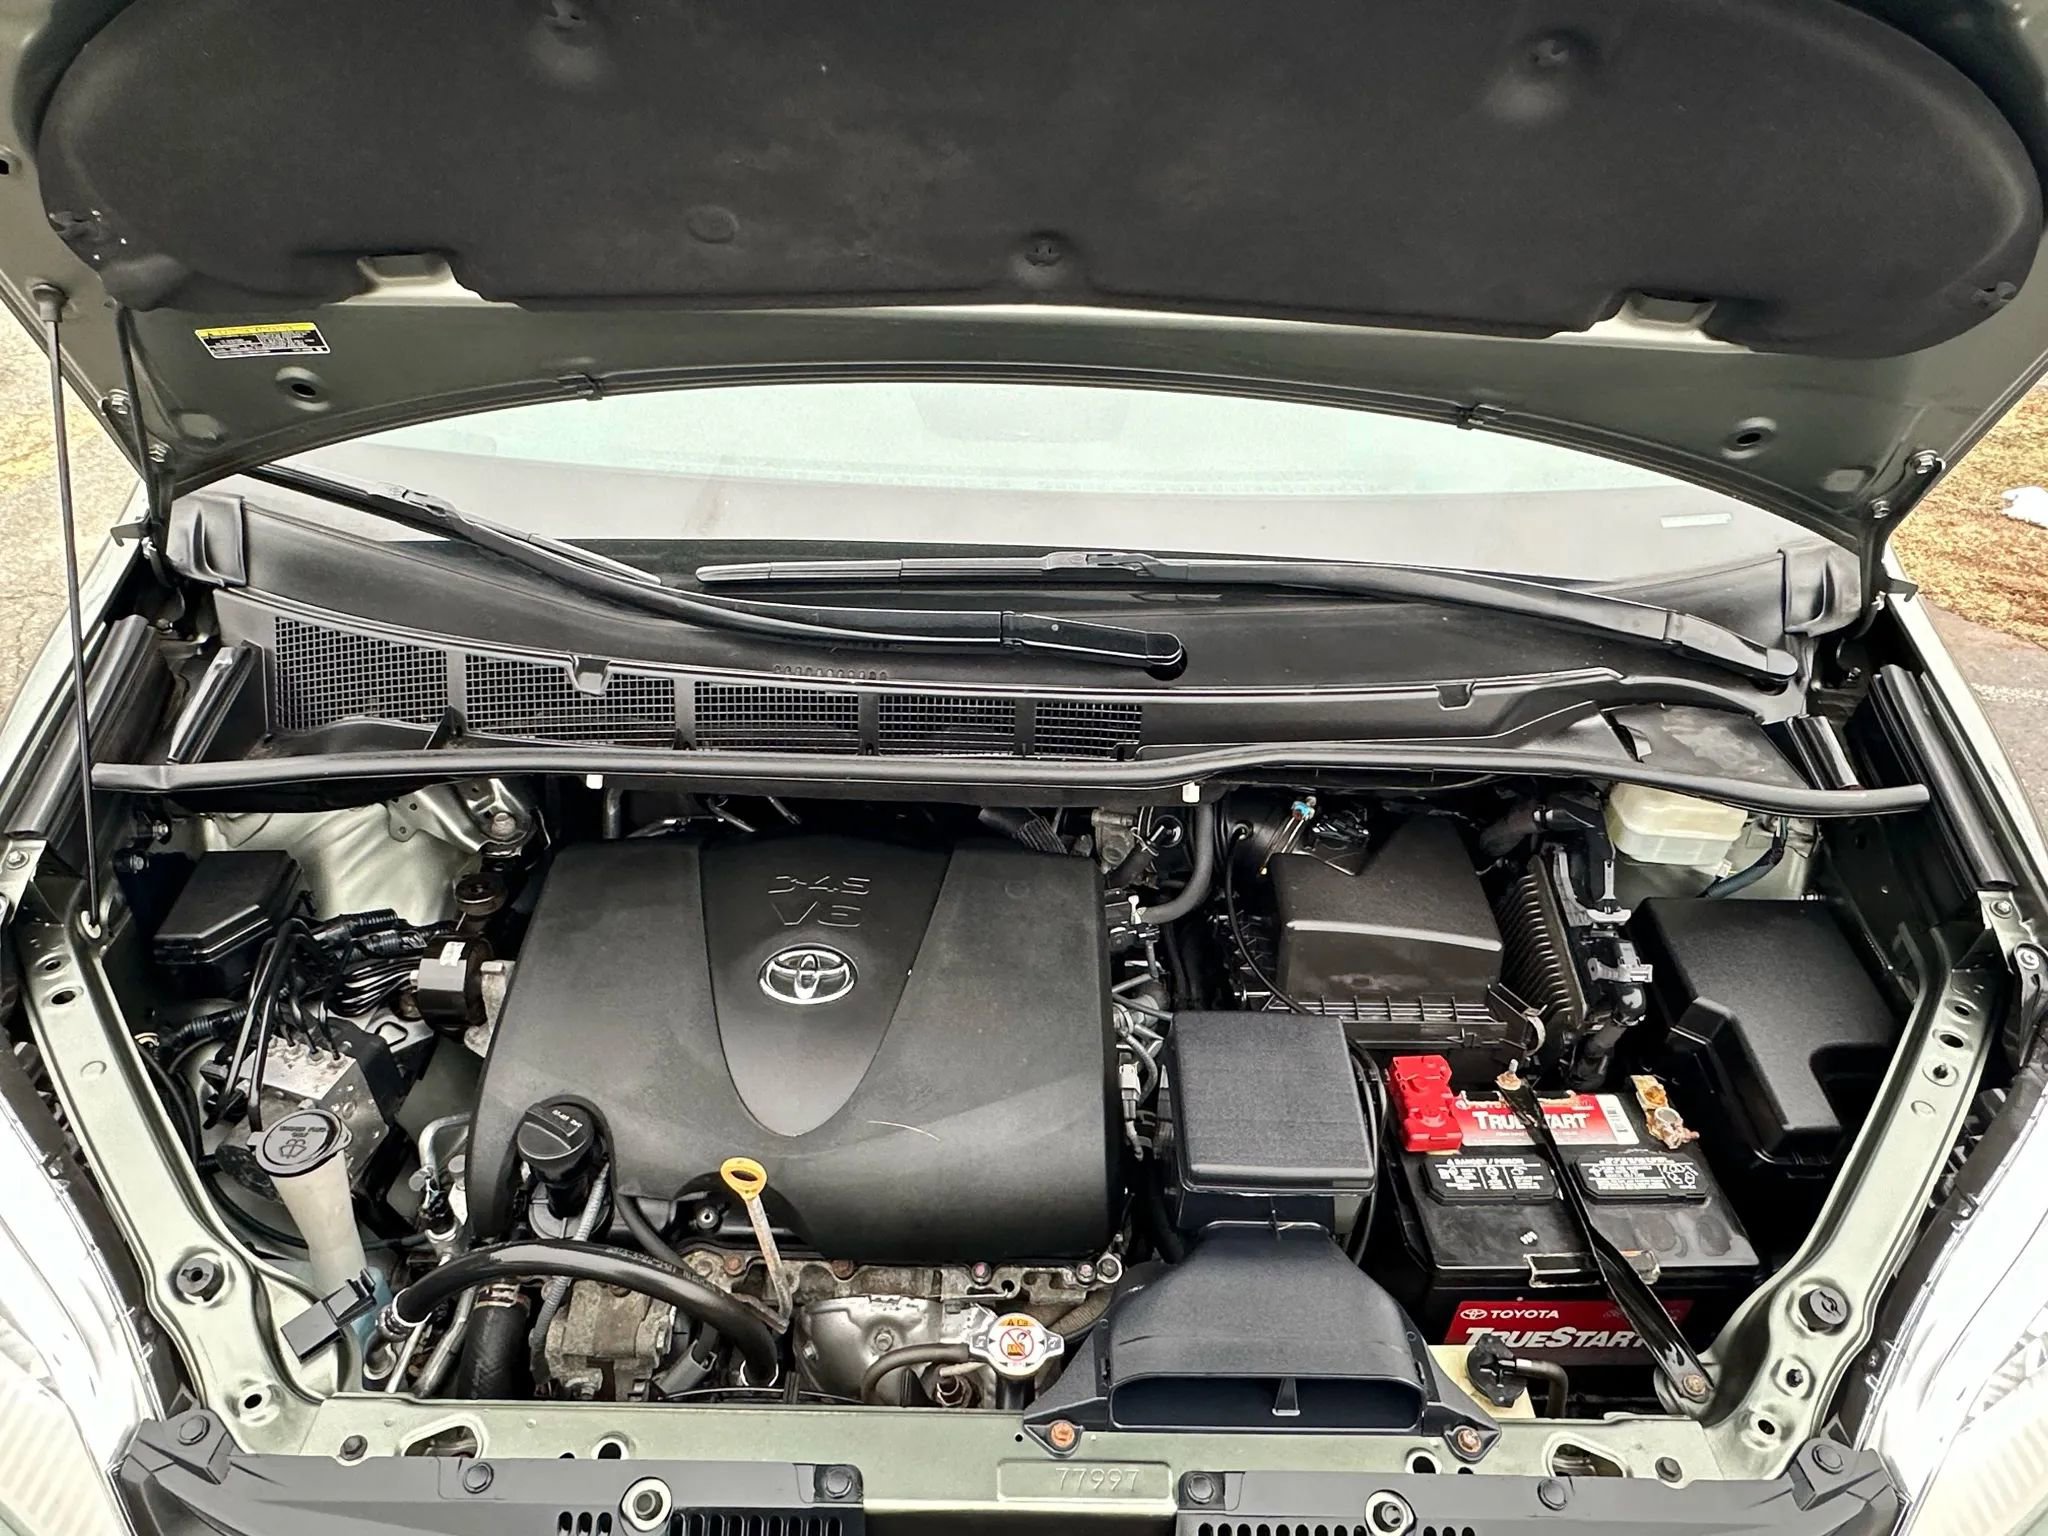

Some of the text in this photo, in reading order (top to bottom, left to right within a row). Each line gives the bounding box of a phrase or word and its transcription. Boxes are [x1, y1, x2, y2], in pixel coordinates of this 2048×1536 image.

[769, 901, 863, 928] V6
[1472, 1111, 1587, 1129] TRUART
[1490, 1309, 1559, 1319] TOYOTA
[1055, 1467, 1140, 1491] 77997
